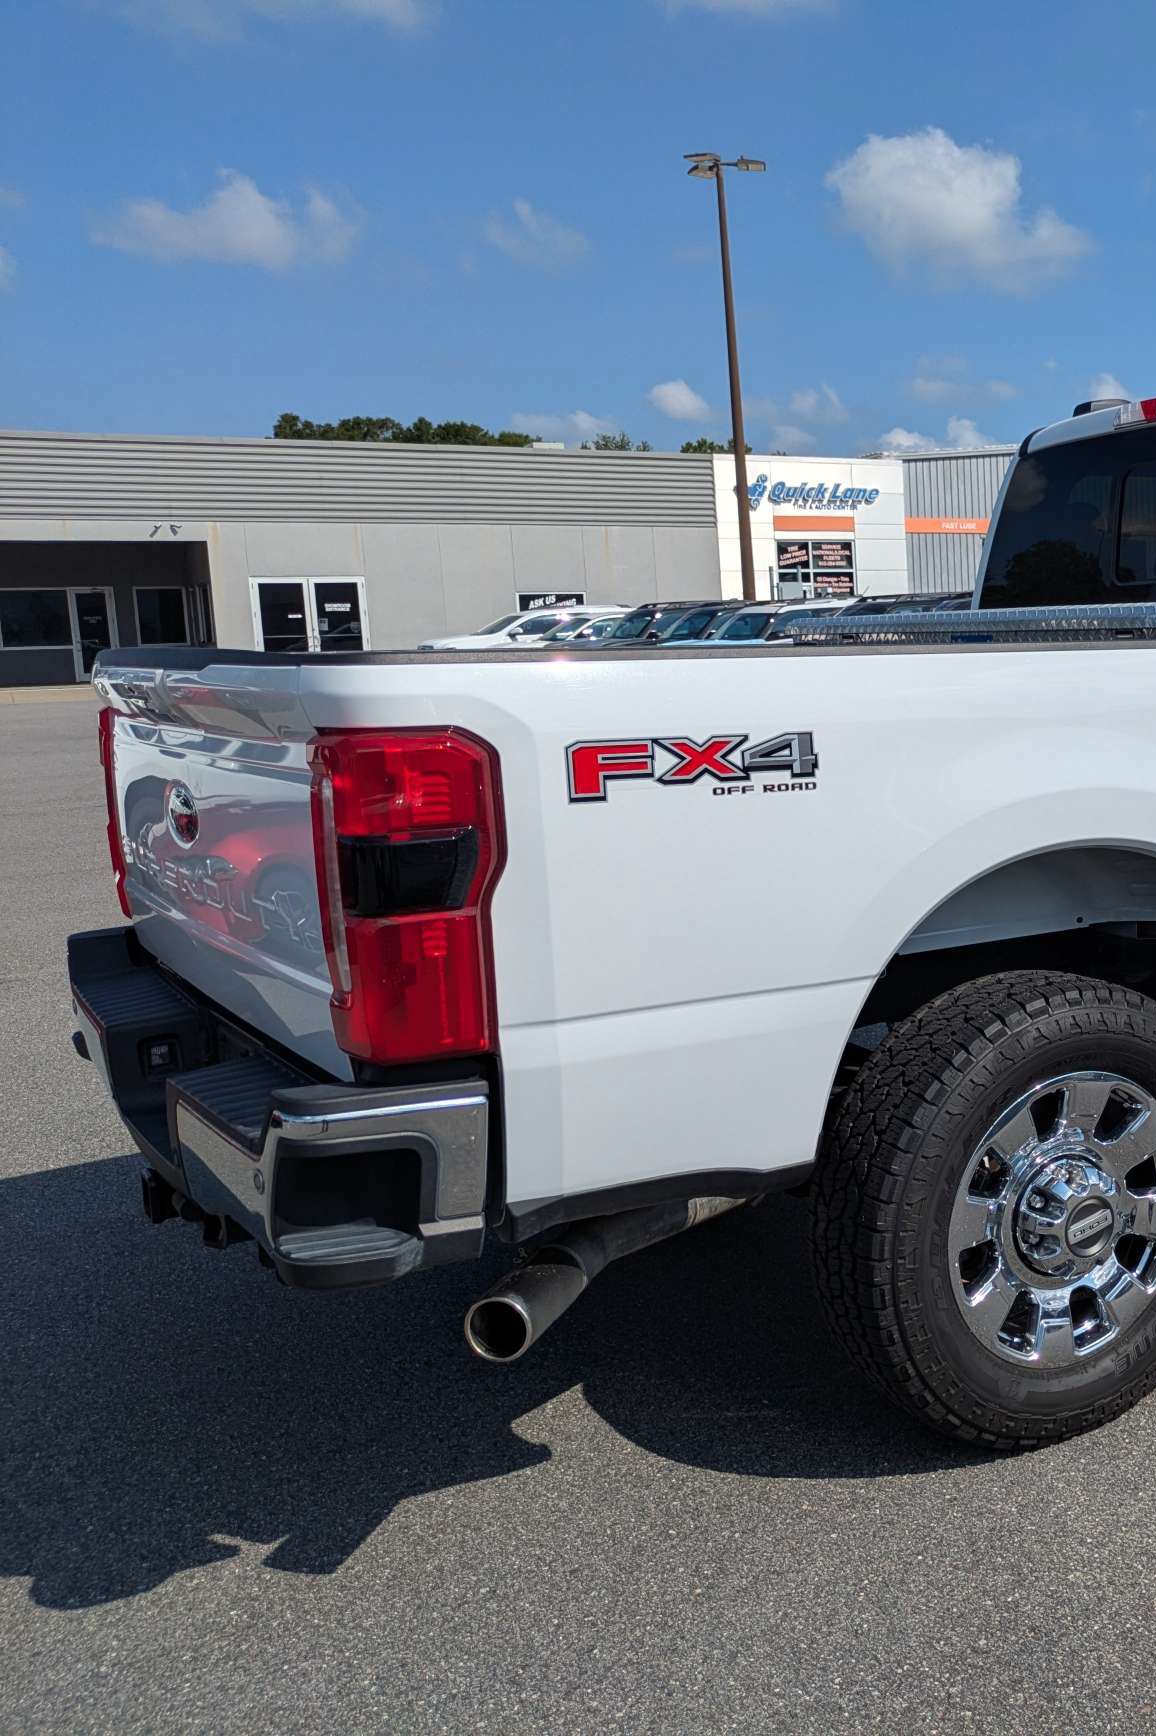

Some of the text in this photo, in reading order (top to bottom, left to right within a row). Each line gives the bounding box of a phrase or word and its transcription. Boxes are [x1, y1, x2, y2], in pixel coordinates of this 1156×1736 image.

[768, 481, 880, 506] Quick Lane
[528, 597, 545, 609] ASK
[545, 594, 556, 605] US
[565, 731, 818, 804] FX4
[712, 781, 818, 796] OFF ROAD
[1073, 1214, 1109, 1238] FORD
